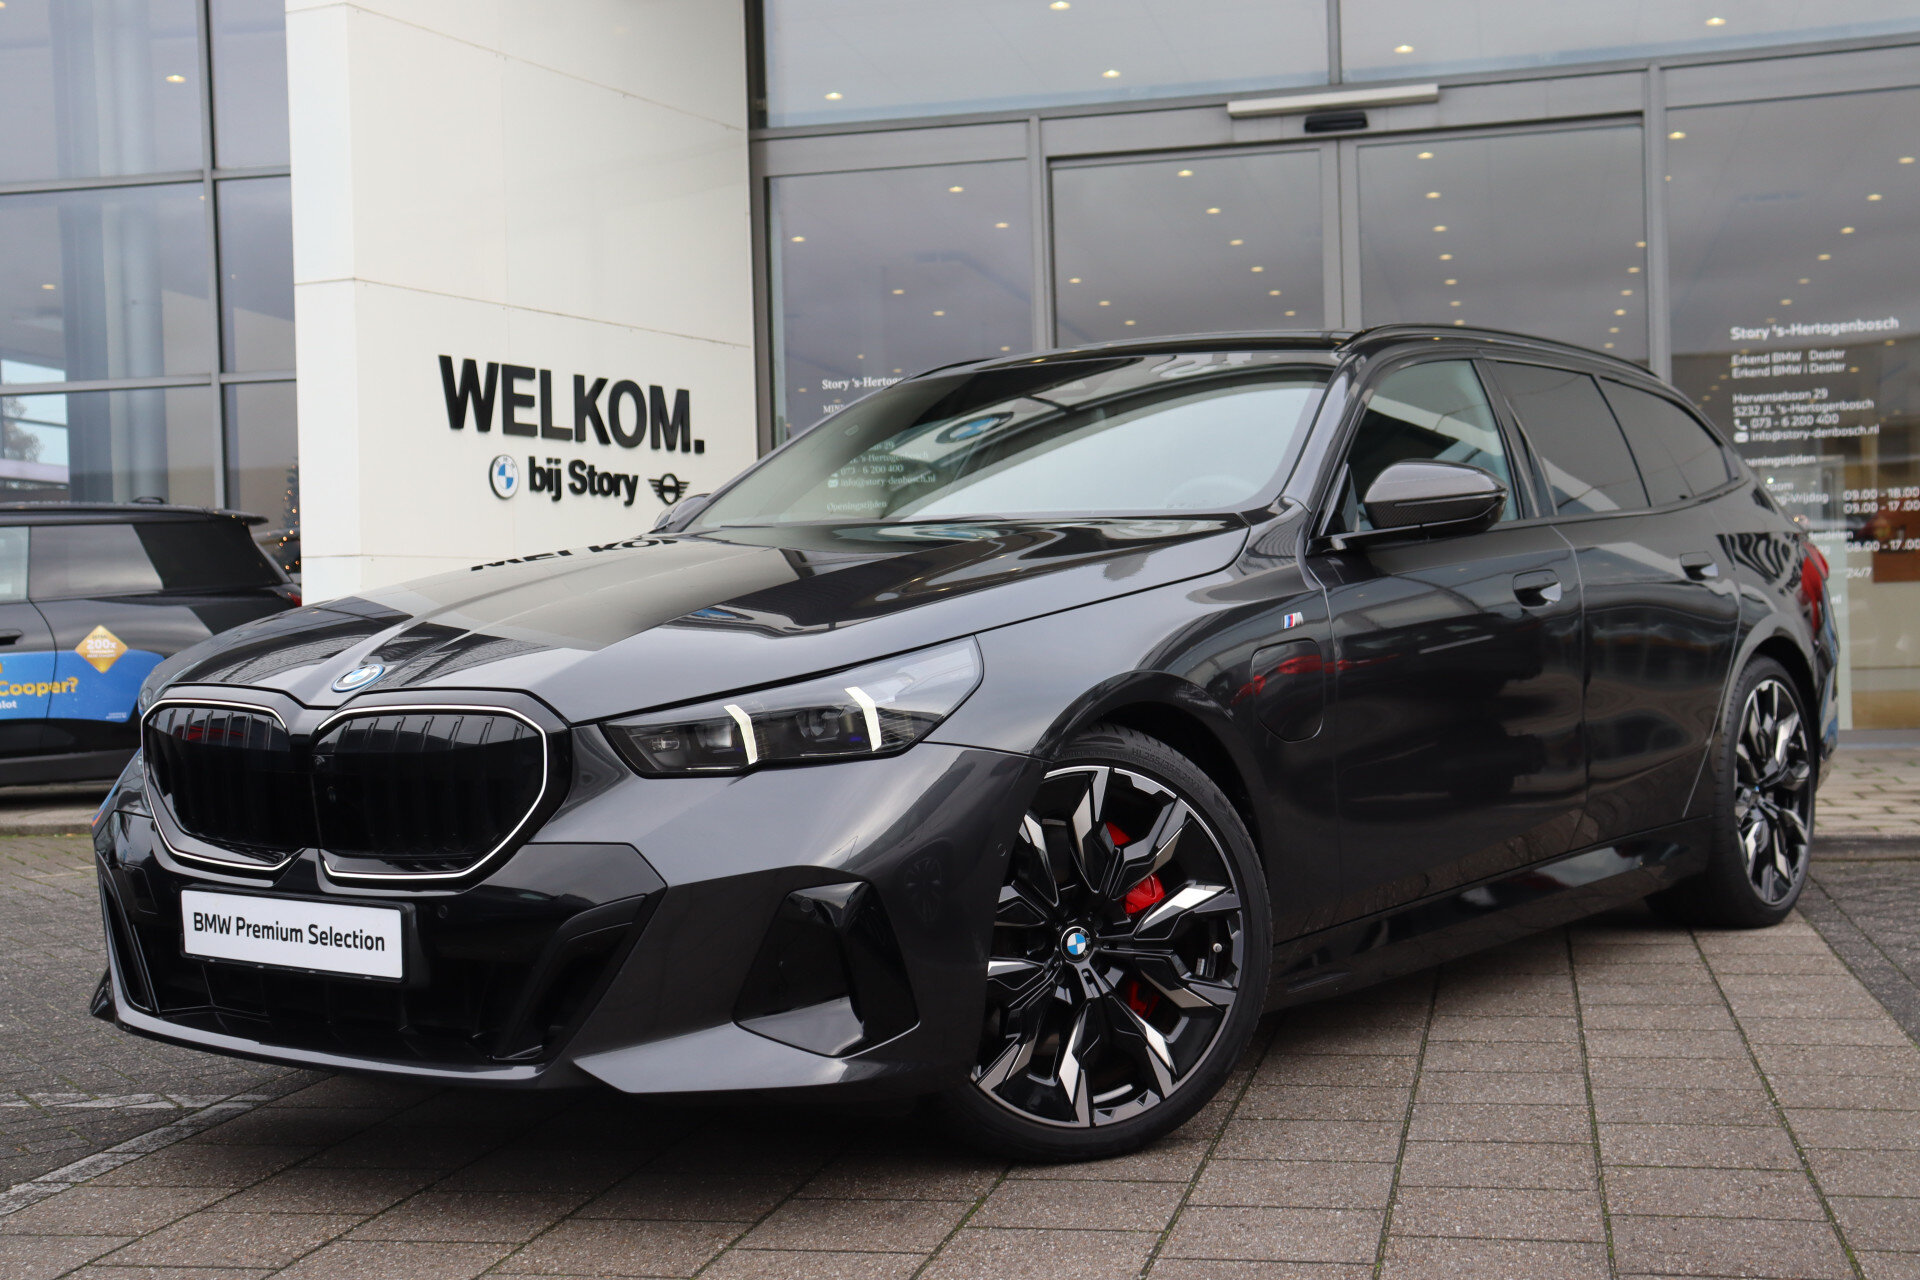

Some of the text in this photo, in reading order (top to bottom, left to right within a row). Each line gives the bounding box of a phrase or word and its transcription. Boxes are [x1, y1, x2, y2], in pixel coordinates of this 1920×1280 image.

[1730, 326, 1770, 341] Story
[1771, 352, 1802, 363] BMW
[1808, 349, 1846, 361] Dealer
[1772, 364, 1802, 377] BMW
[1809, 362, 1846, 374] Dealer
[822, 377, 849, 391] Story
[438, 354, 705, 454] WELKOM.
[1791, 414, 1814, 427] 200
[1815, 412, 1840, 425] 400
[528, 456, 639, 507] bij Story
[86, 638, 117, 650] 200x
[192, 911, 385, 952] BMW Premium Selection
